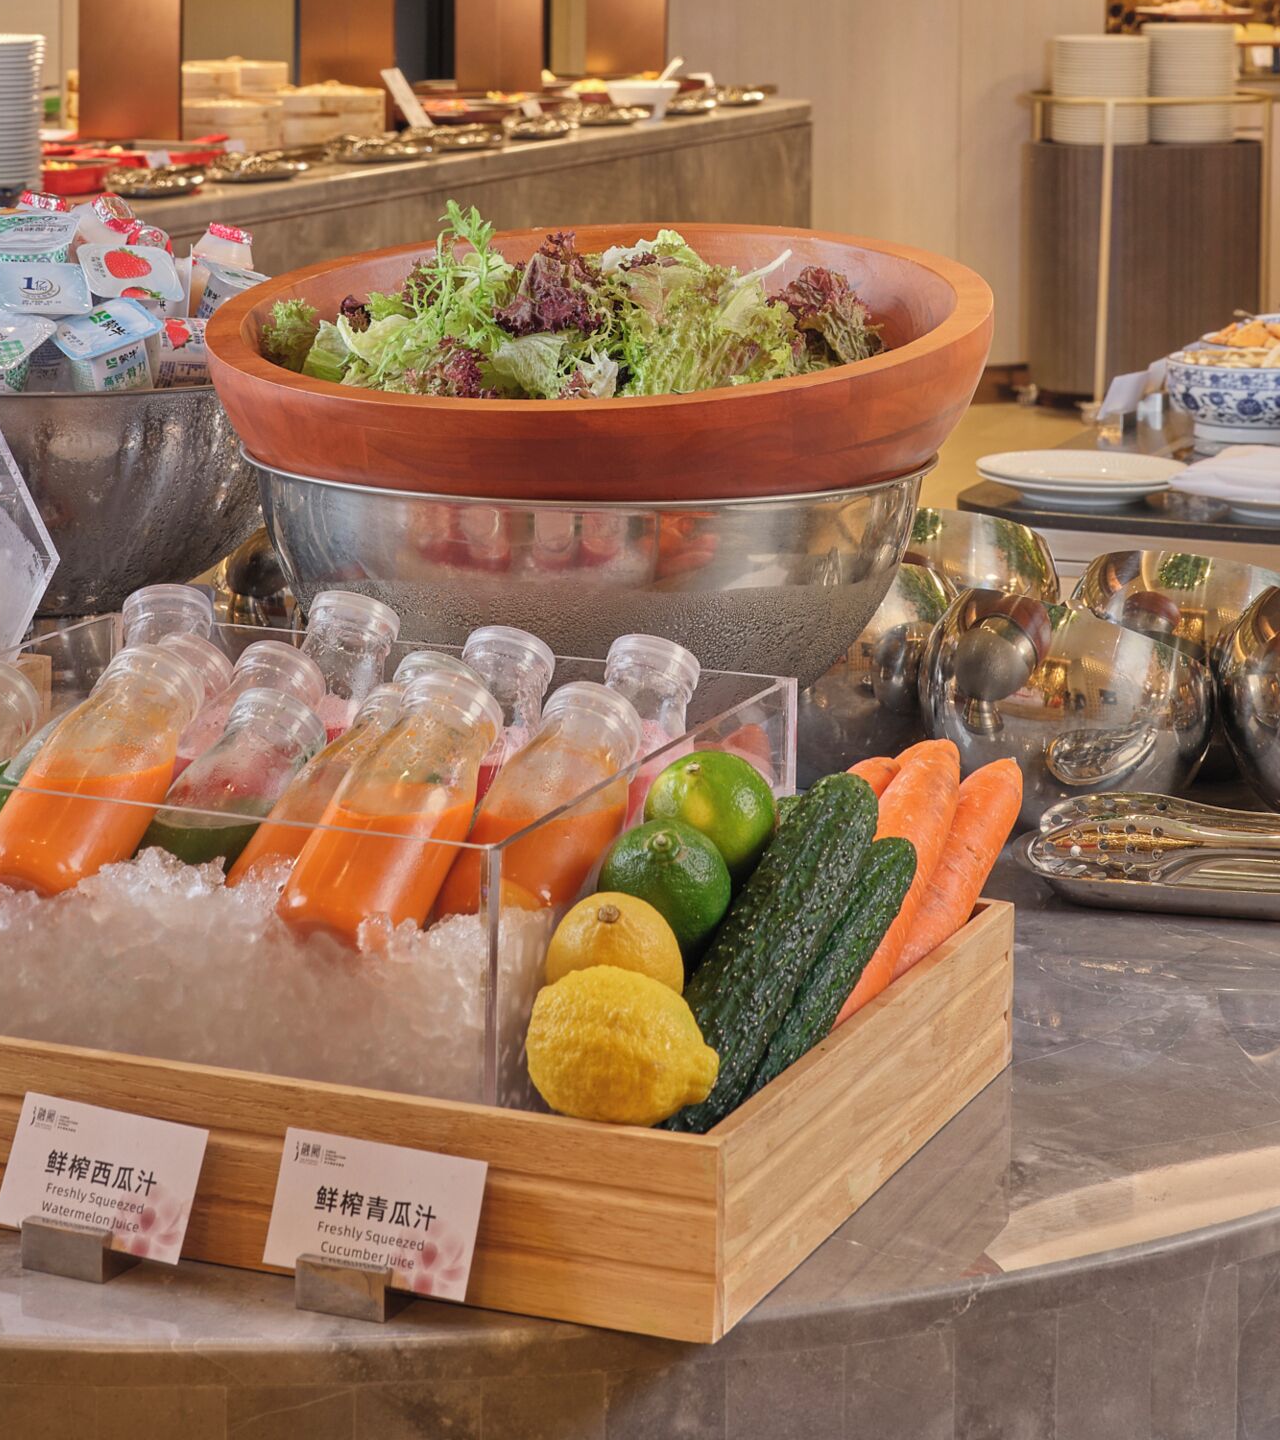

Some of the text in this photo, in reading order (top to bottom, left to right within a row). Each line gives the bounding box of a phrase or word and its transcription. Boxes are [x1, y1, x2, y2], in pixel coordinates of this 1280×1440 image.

[44, 1149, 157, 1197] 鲜榨西瓜汁
[45, 1182, 145, 1215] Freshly Squeezed
[314, 1185, 437, 1232] 鲜榨青瓜汁
[42, 1200, 140, 1233] Watermelon Juice
[317, 1220, 425, 1252] Freshly Squeezed
[320, 1241, 415, 1270] Cucumber Juice
